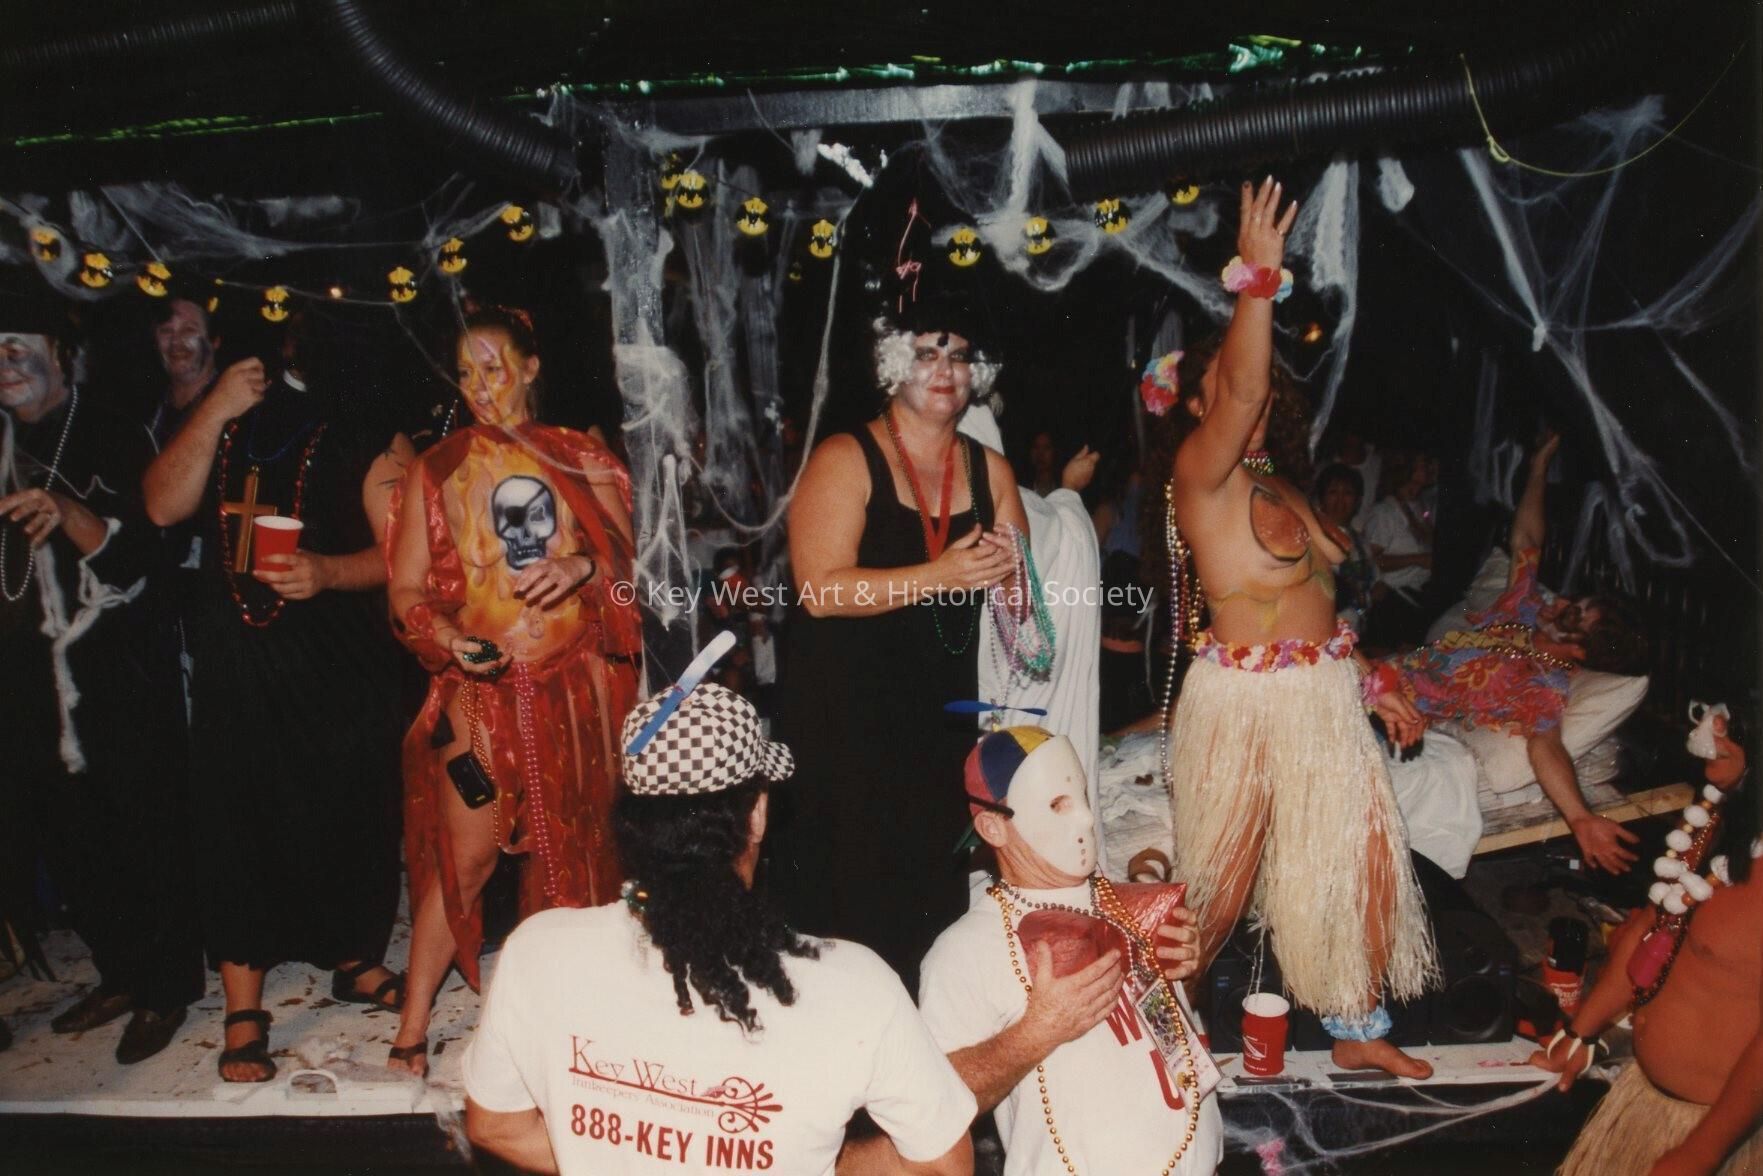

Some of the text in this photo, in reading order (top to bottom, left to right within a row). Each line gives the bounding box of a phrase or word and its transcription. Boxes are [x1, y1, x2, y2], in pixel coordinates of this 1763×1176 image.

[569, 1035, 699, 1097] Key West
[571, 1104, 774, 1170] 888-KEY INNS
